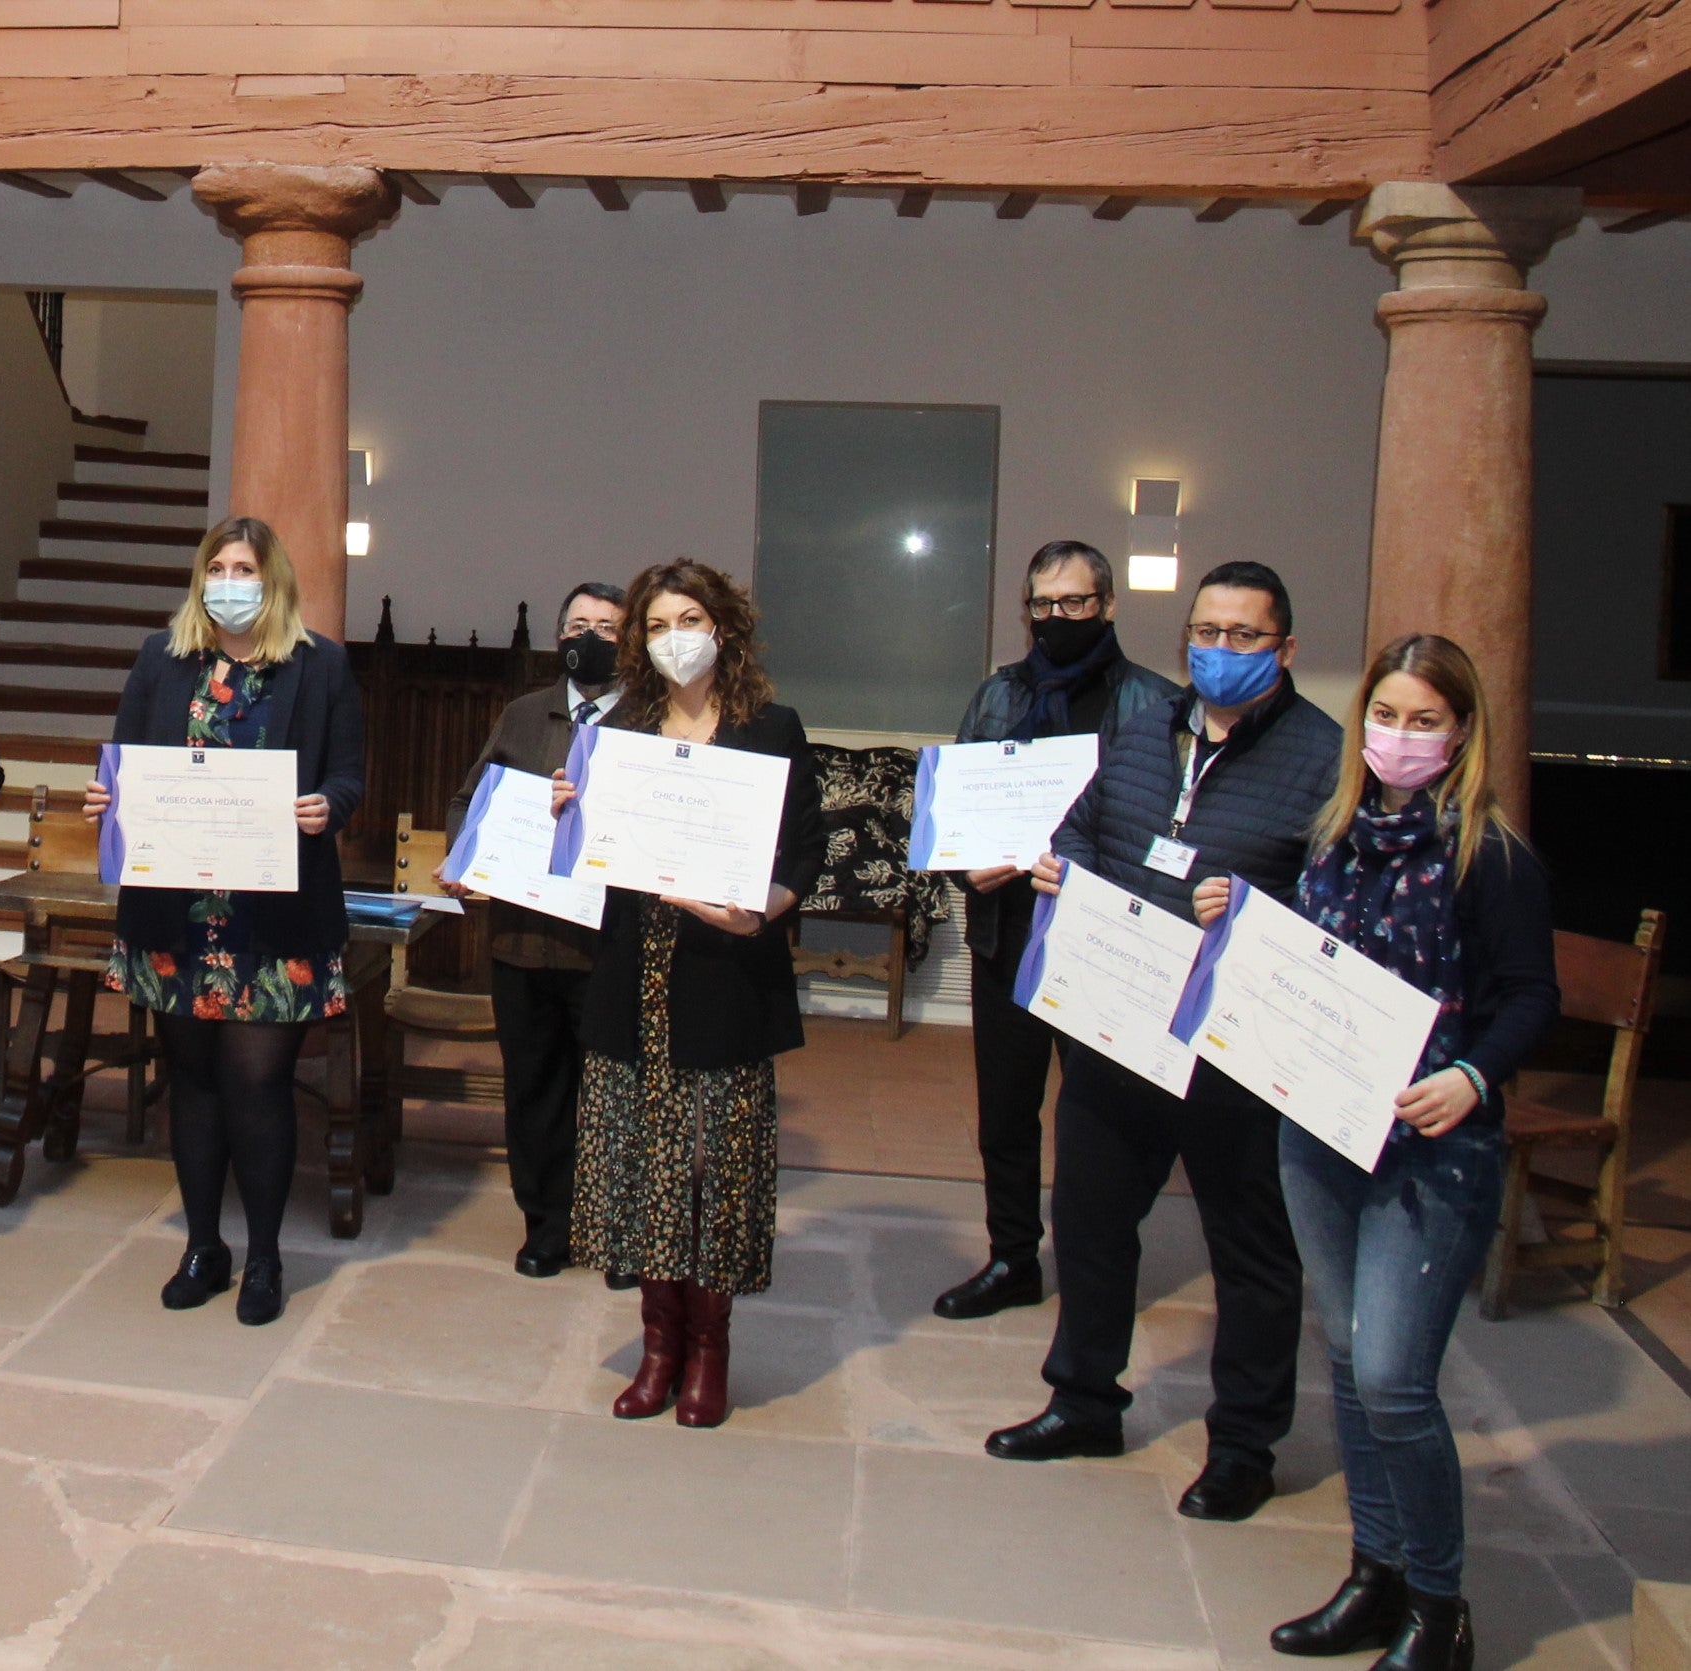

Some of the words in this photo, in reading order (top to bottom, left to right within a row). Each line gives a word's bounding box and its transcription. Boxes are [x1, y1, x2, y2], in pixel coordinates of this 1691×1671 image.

[962, 782, 1013, 791] HOSTELERIA
[1004, 790, 1024, 799] 2015
[156, 796, 187, 804] MUSEO
[189, 797, 212, 805] CASA
[215, 798, 254, 807] HIDALGO
[652, 790, 675, 802] CHIC
[678, 795, 684, 803] &
[687, 797, 710, 808] CHIC
[511, 816, 533, 828] HOTEL
[536, 823, 554, 833] INSU
[1086, 933, 1104, 948] DON
[1105, 943, 1141, 968] QUIXOTE
[1142, 962, 1173, 983] TOURS
[1271, 972, 1298, 995] PEAU
[1309, 999, 1342, 1025] ANGEL
